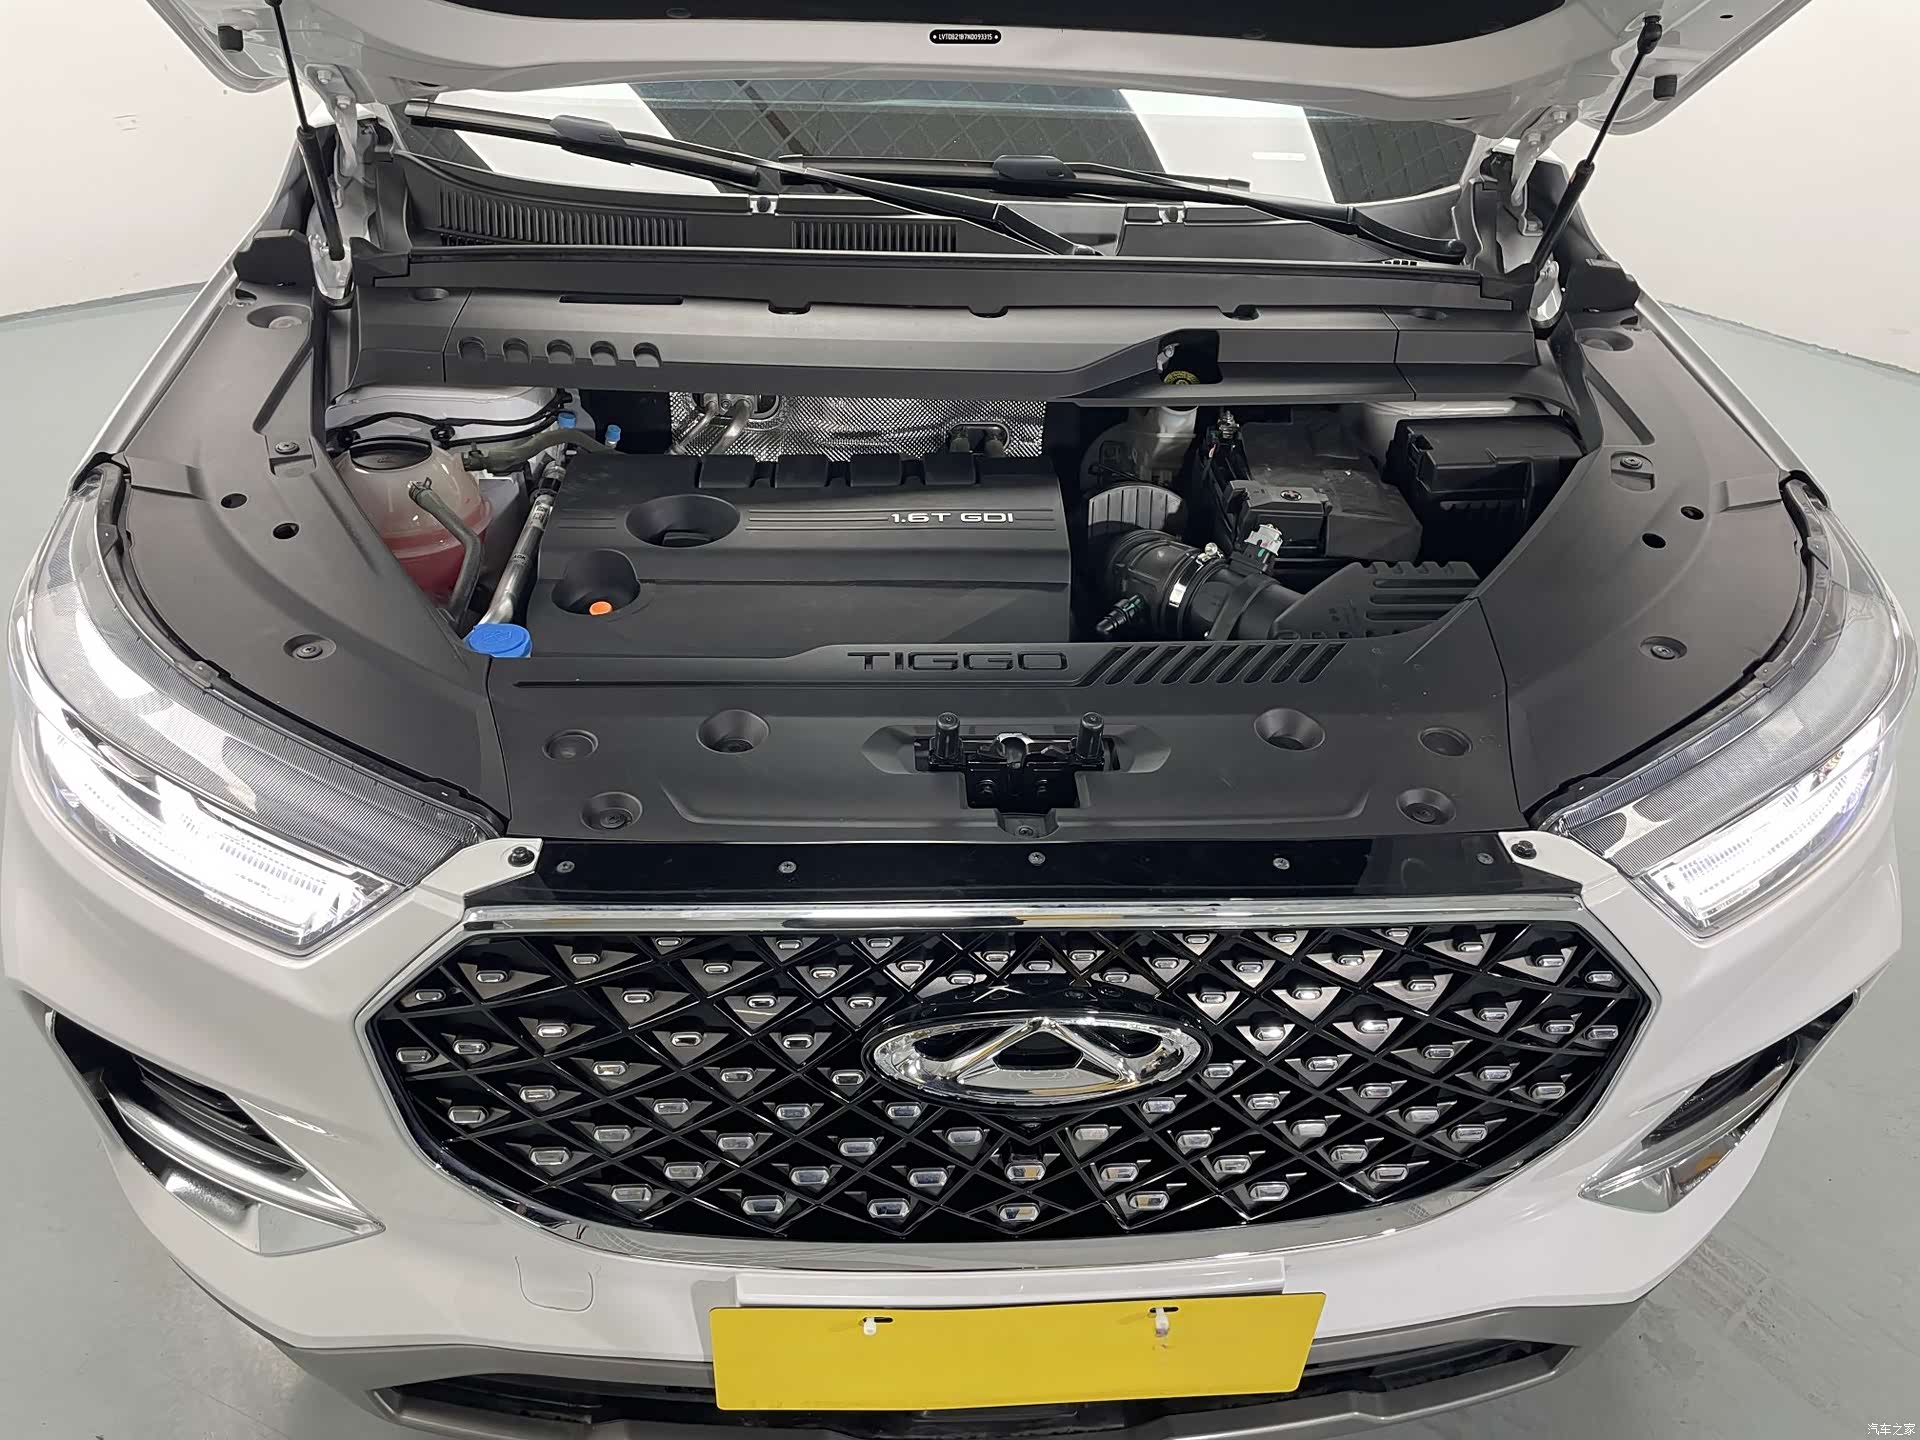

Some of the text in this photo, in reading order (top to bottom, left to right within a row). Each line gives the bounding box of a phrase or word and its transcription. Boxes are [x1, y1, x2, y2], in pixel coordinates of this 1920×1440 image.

[891, 512, 1014, 523] 1.6T GDI
[847, 652, 1068, 671] TIGGO
